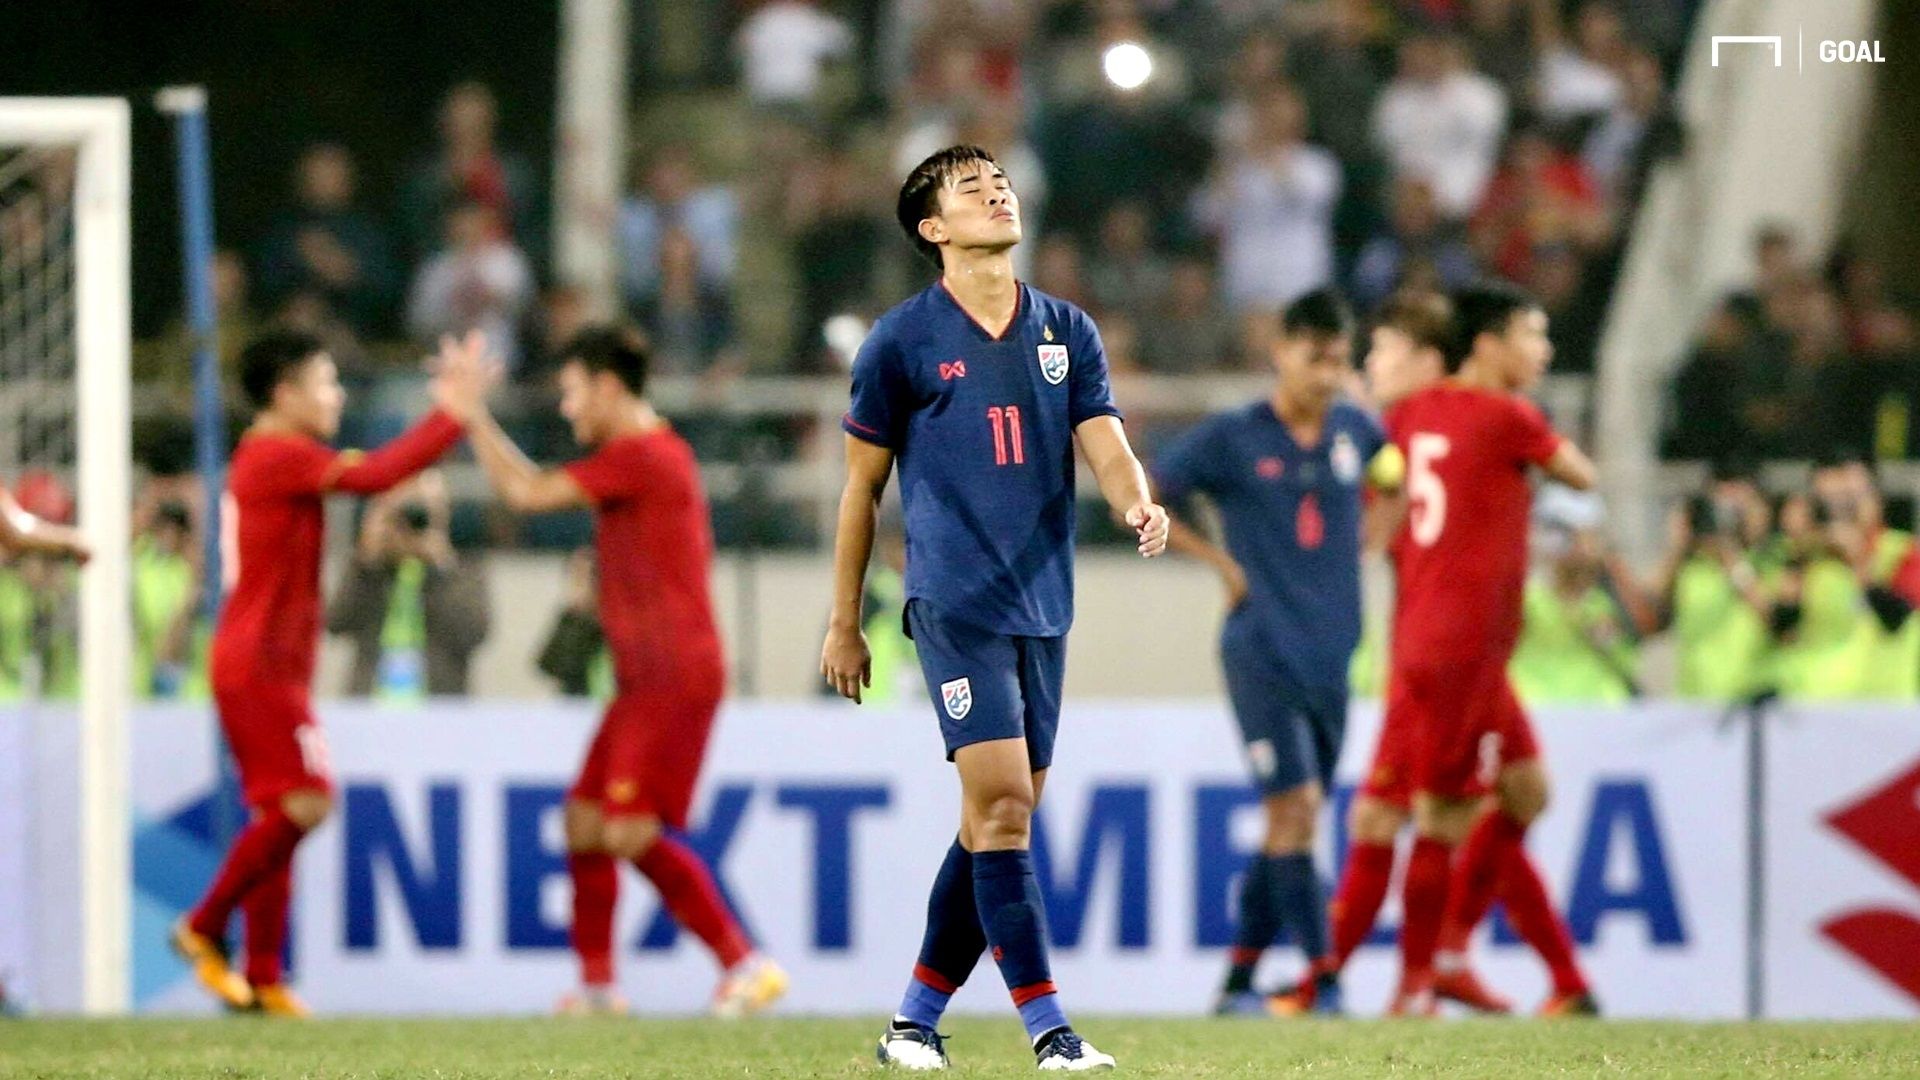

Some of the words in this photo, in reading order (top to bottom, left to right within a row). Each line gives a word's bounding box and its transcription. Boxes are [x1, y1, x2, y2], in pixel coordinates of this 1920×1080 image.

[987, 405, 1024, 465] 11
[1408, 432, 1450, 547] 5
[1030, 780, 1689, 948] MEA
